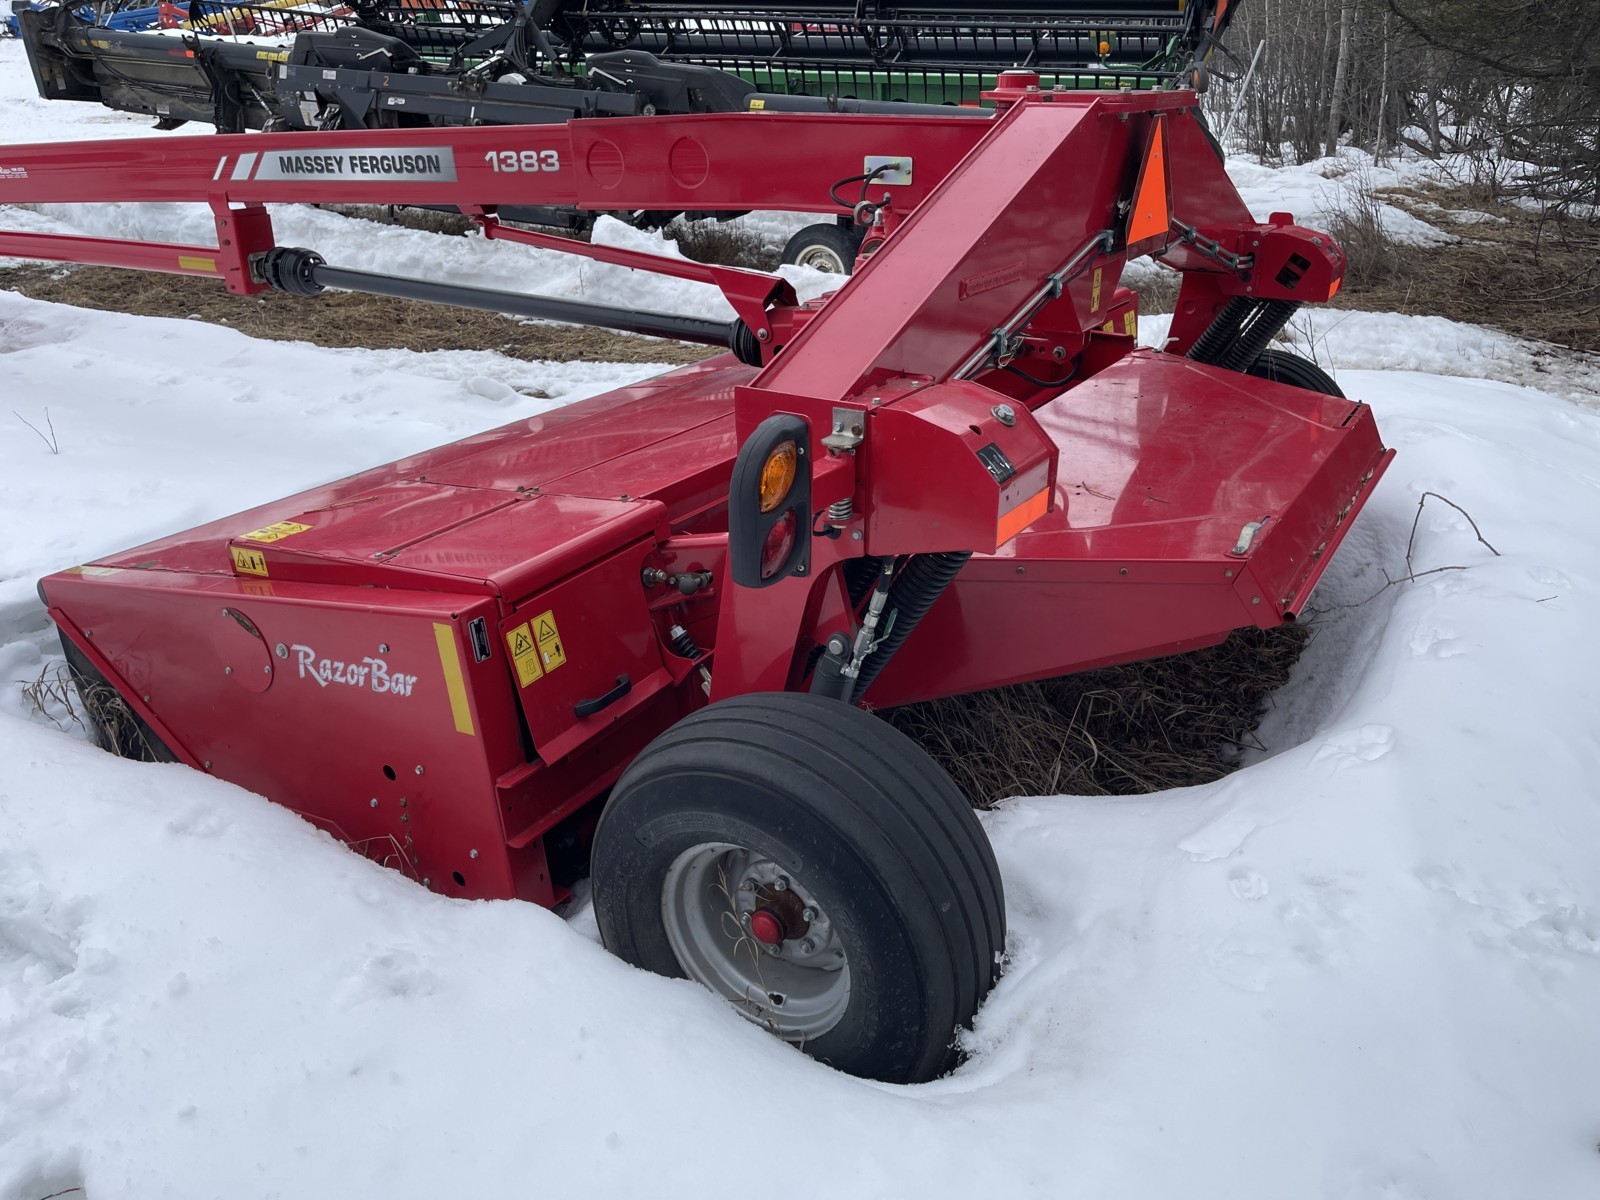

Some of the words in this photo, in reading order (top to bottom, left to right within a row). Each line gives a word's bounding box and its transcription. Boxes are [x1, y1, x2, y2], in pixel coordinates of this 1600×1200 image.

[383, 75, 390, 86] 2
[278, 155, 344, 174] MASSEY
[350, 154, 441, 174] FERGUSON
[484, 151, 560, 173] 1383
[290, 643, 418, 697] RazorBar
